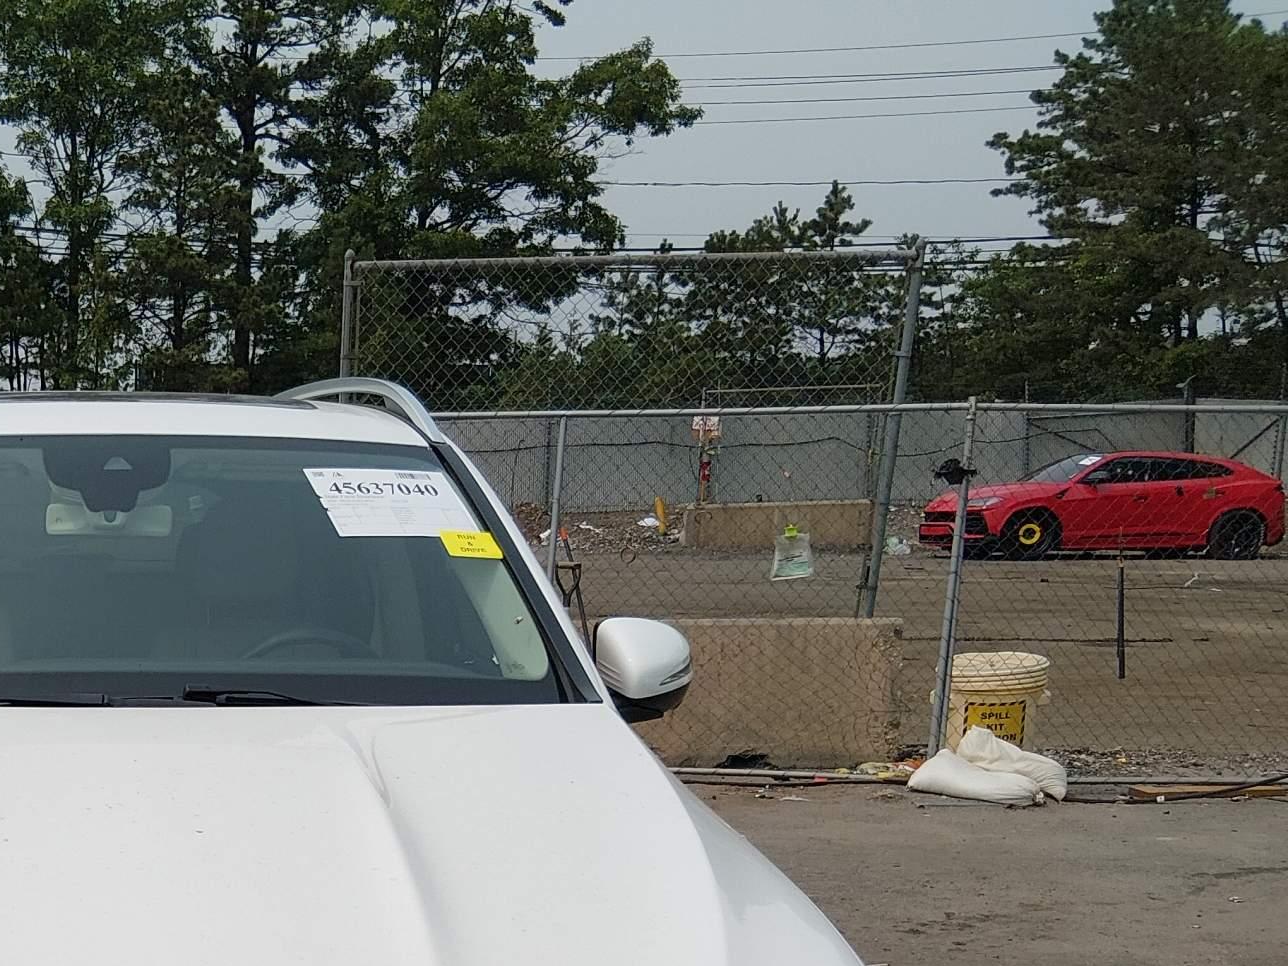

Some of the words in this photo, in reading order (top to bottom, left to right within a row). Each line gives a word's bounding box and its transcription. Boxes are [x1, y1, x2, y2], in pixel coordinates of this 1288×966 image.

[329, 481, 439, 497] 45637040
[980, 711, 1011, 720] SPILL
[985, 723, 1005, 731] KIT
